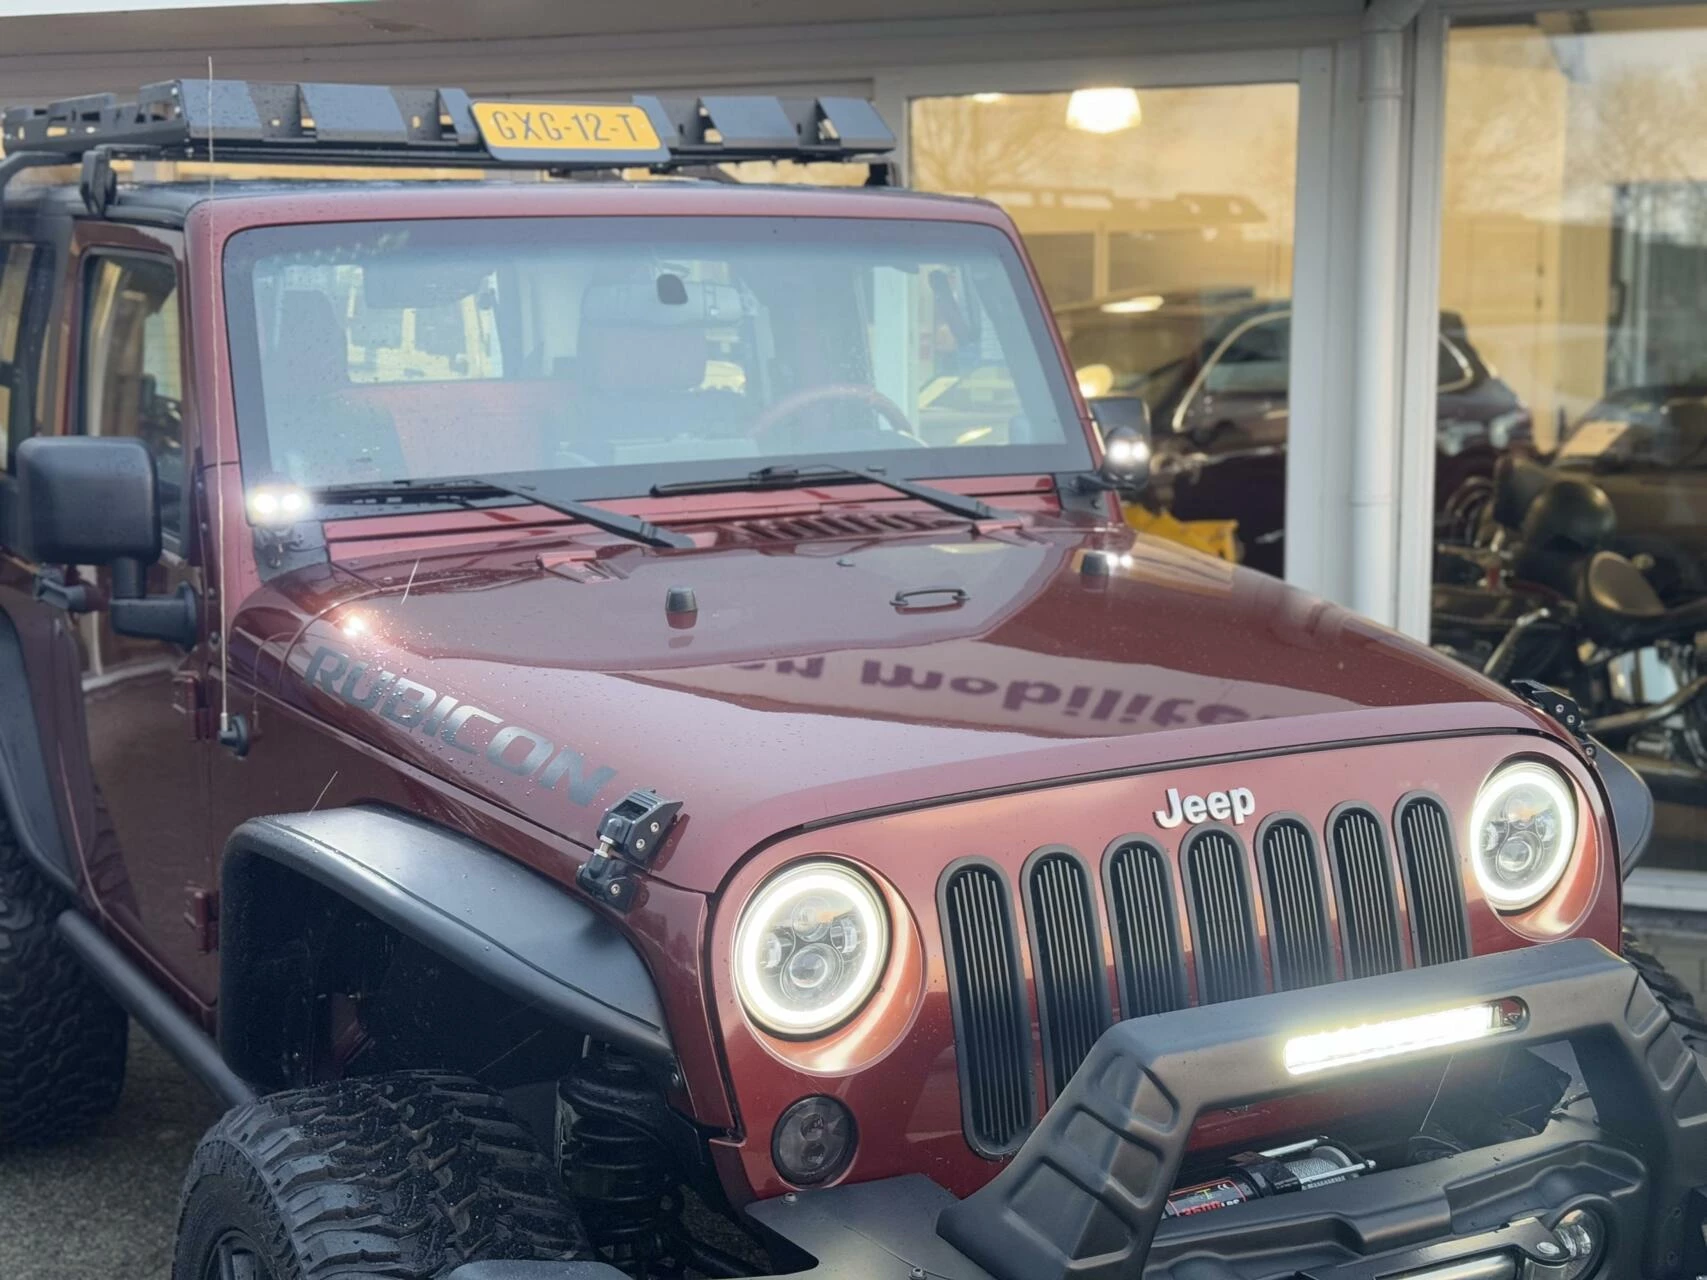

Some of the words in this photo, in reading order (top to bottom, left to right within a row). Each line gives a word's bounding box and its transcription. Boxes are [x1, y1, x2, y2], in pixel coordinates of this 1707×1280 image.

[492, 110, 638, 142] GXG-12-T
[304, 645, 618, 808] RUBICON
[1153, 787, 1256, 829] Jeep
